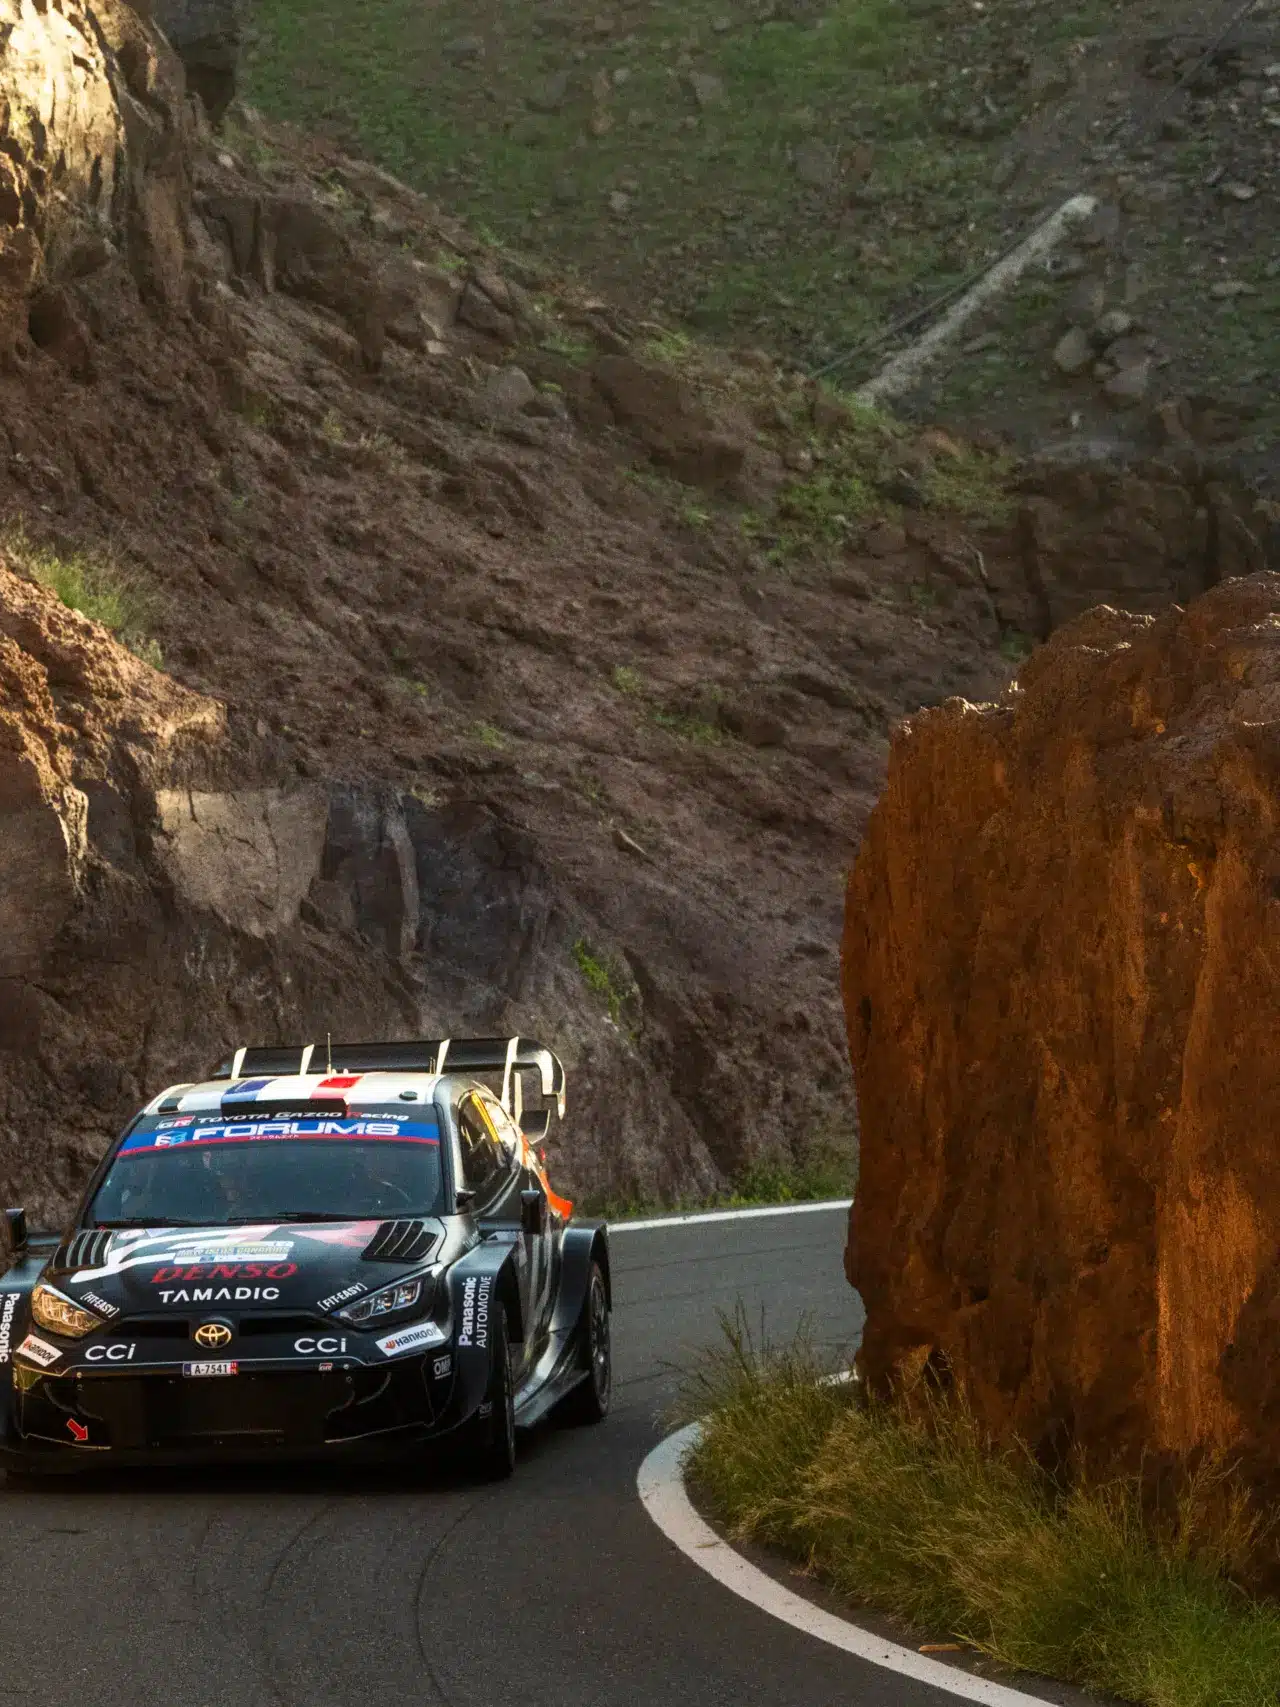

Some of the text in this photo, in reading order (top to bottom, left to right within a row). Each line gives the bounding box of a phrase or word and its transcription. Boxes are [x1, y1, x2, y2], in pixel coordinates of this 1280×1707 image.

[198, 1113, 270, 1124] TOYOTA
[192, 1121, 400, 1141] FORUM8
[150, 1263, 298, 1284] DENSO
[159, 1287, 280, 1304] TAMADIC
[458, 1276, 477, 1346] Panasonic
[476, 1276, 492, 1348] AUTOMOTIVE
